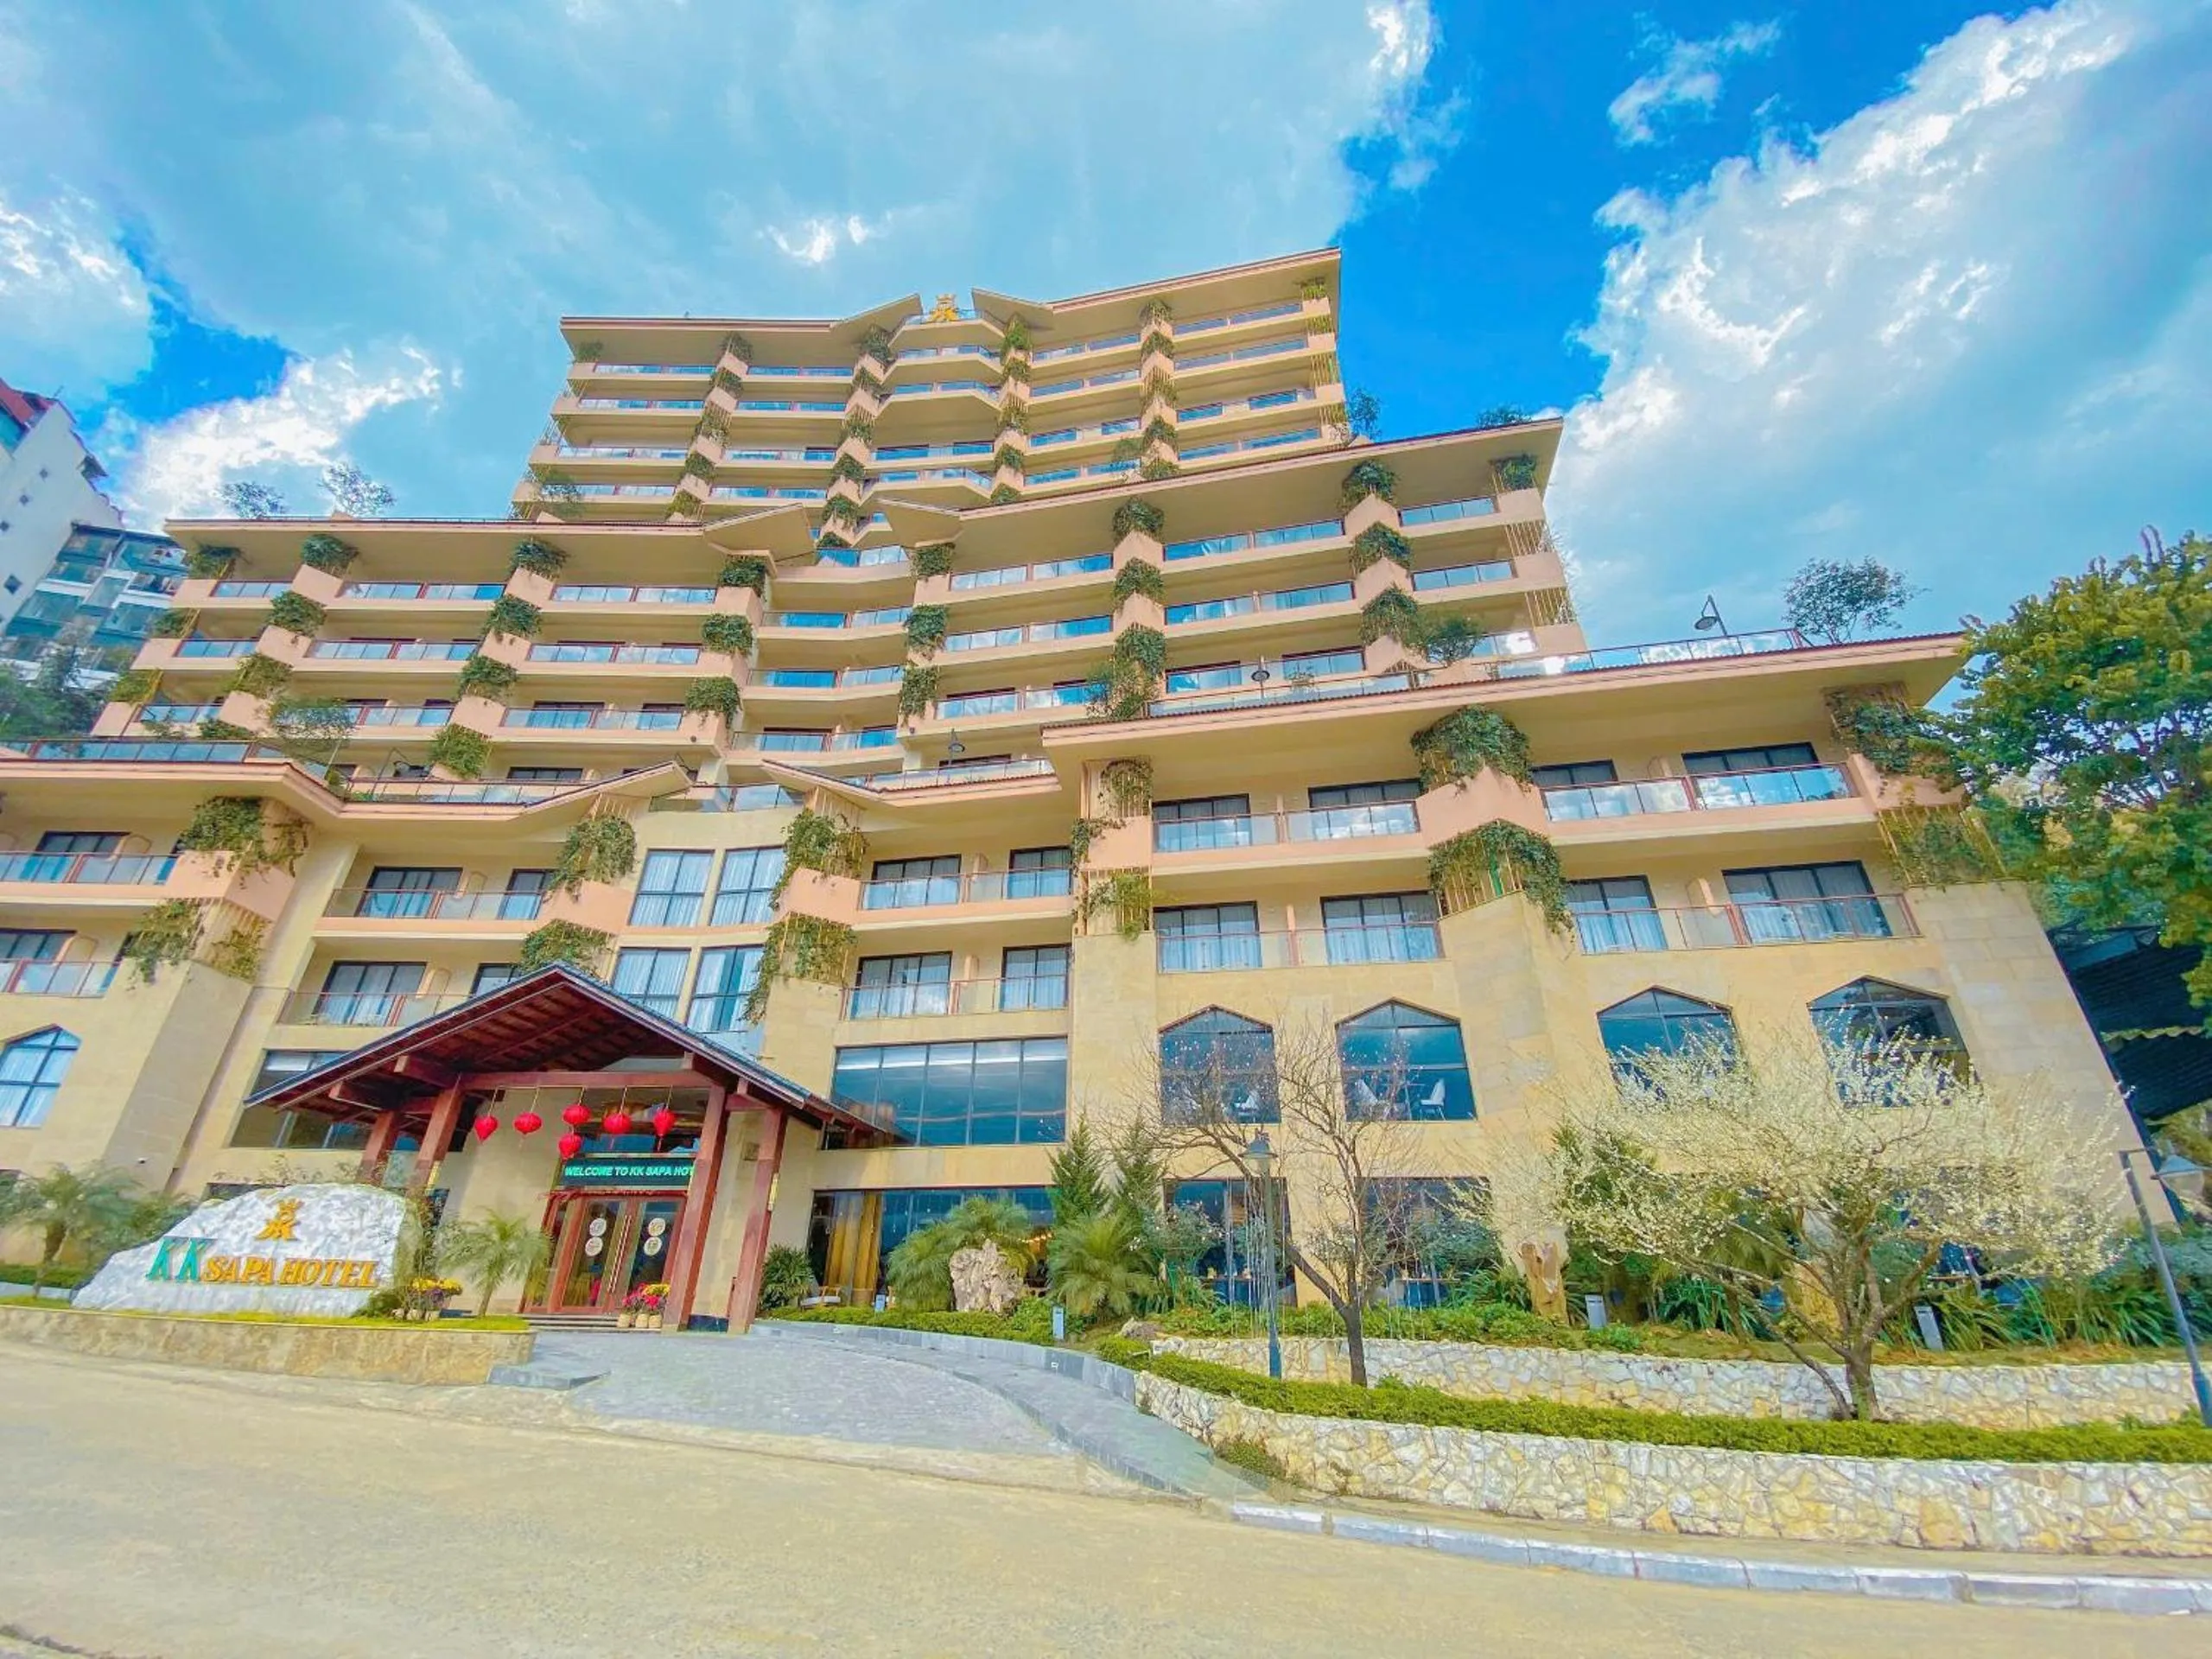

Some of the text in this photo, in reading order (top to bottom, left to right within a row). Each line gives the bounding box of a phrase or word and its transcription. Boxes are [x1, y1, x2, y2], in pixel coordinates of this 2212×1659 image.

[565, 1166, 613, 1176] WELCOME
[615, 1166, 628, 1176] TO
[629, 1166, 645, 1176] KK
[645, 1166, 671, 1176] SAPA
[201, 1256, 274, 1286] SAPA
[278, 1258, 379, 1287] HOTEL
